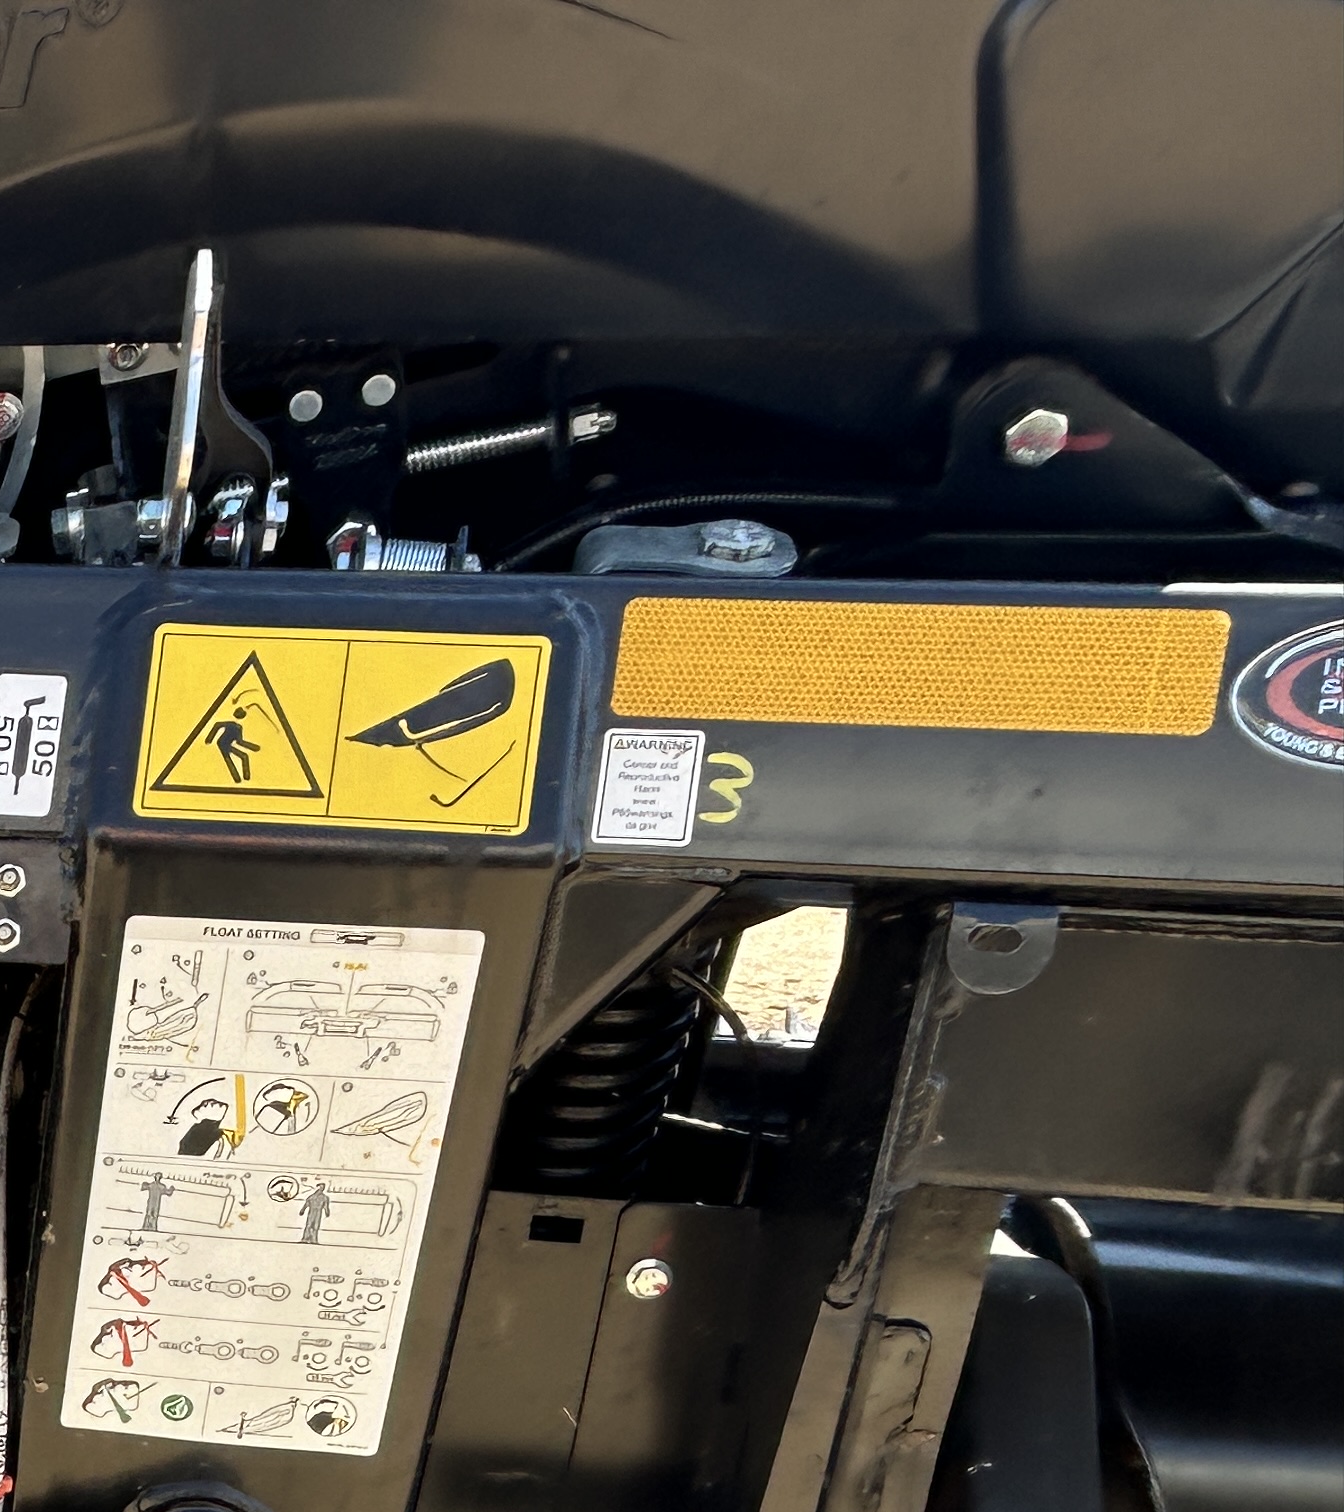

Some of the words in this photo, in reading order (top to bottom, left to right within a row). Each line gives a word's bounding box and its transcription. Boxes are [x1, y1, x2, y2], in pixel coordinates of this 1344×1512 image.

[32, 740, 55, 777] 50
[697, 751, 755, 824] 3
[202, 926, 244, 938] FLOAT
